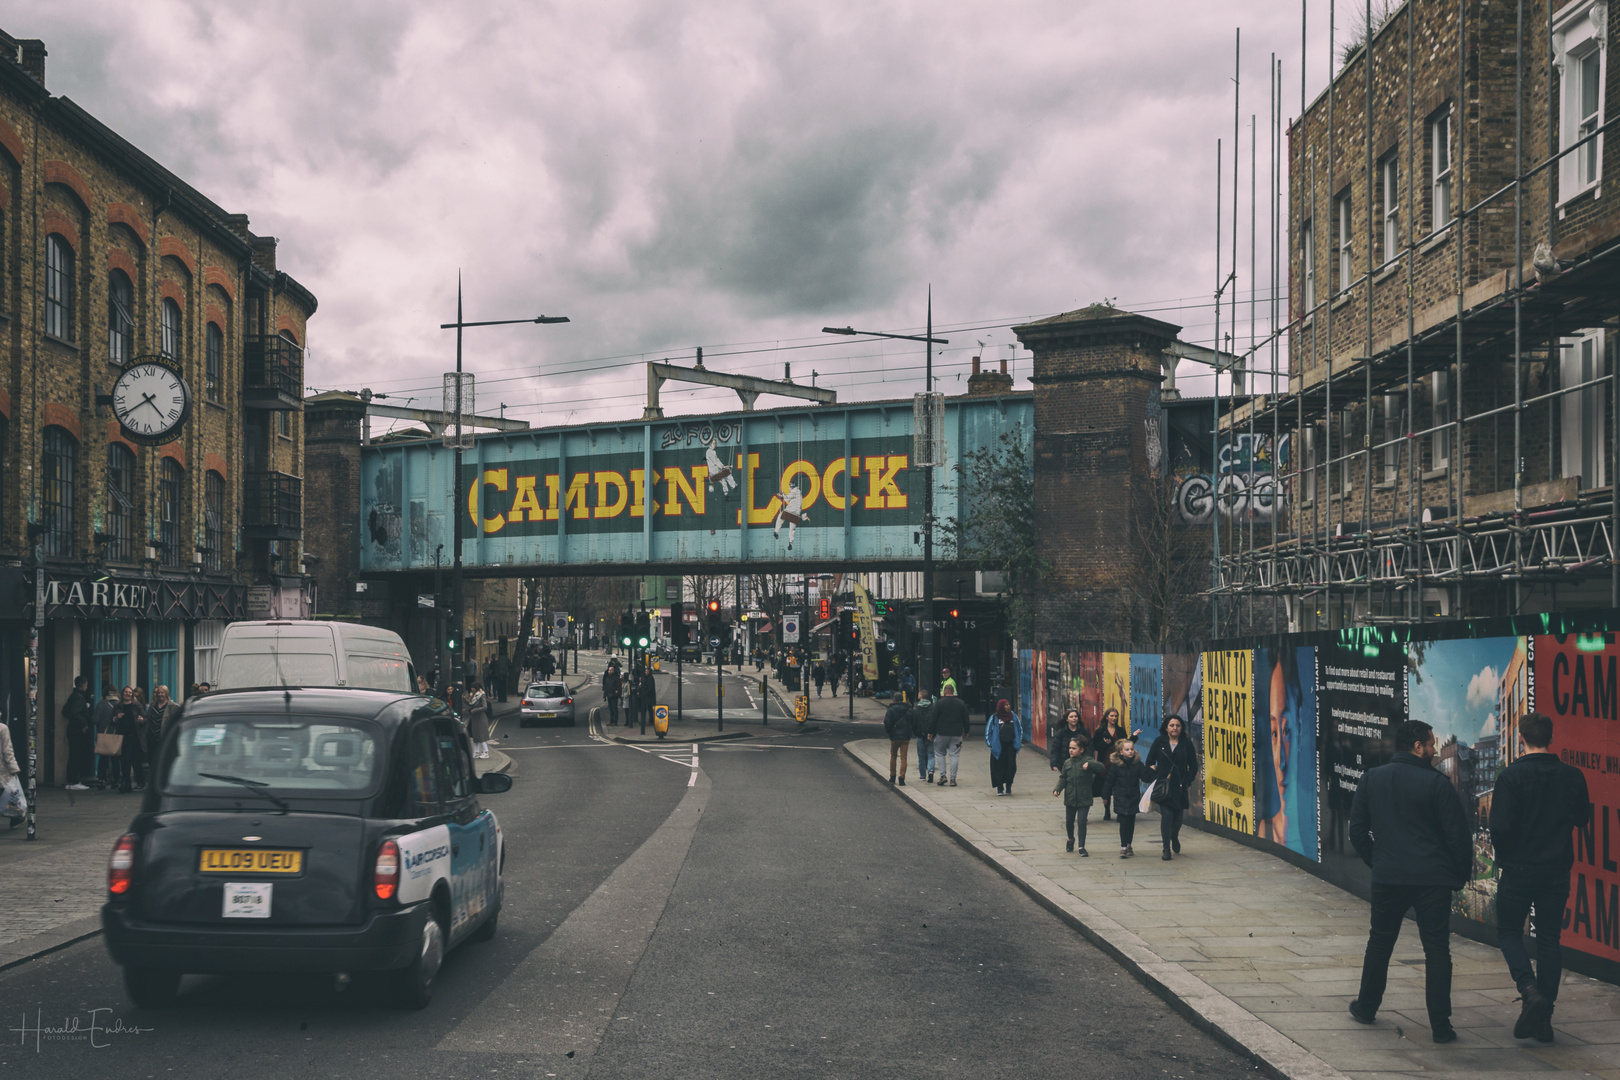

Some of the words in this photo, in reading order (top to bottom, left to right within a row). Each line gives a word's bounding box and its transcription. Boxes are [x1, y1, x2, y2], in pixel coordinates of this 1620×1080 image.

[124, 355, 157, 370] CAMDEN
[159, 356, 180, 372] LOCK
[467, 465, 709, 534] CAMDEN
[736, 452, 909, 525] LOCK
[43, 580, 148, 609] MARKET
[1133, 665, 1158, 697] COMING
[1206, 650, 1231, 685] WANT
[1234, 650, 1247, 688] TO
[1341, 668, 1349, 677] more
[1350, 667, 1359, 677] about
[1376, 670, 1395, 681] restaurant
[1366, 684, 1375, 694] team
[1375, 684, 1379, 697] by
[1527, 666, 1535, 714] WHARF
[1552, 651, 1618, 721] CAM
[1134, 696, 1158, 729] SOON
[1208, 687, 1219, 722] BE
[1222, 690, 1247, 728] PART
[1208, 724, 1219, 760] OF
[1220, 728, 1247, 770] THIS?
[1561, 748, 1620, 775] @HAWLEY_WH
[207, 852, 254, 869] LL09
[258, 853, 294, 869] UEU
